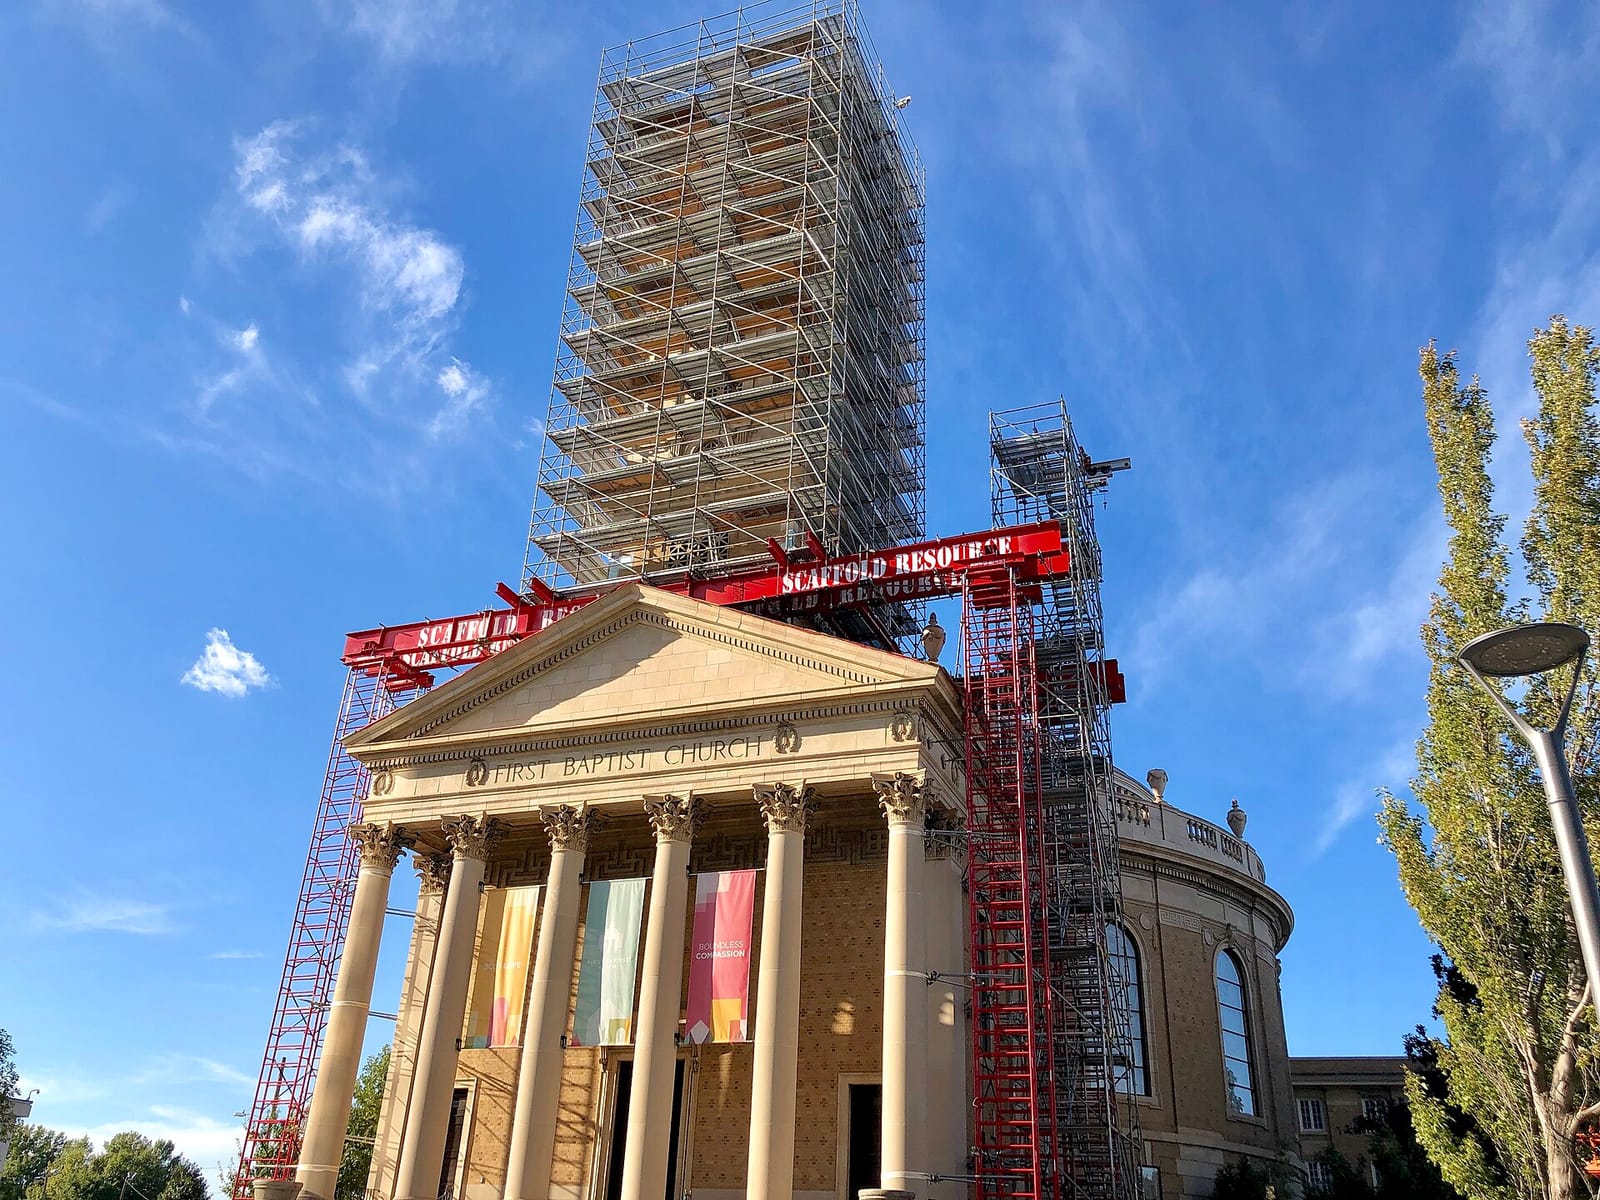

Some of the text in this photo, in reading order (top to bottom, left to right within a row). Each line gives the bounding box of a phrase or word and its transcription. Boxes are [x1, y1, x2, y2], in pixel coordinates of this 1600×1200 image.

[782, 557, 887, 594] SCAFFOLD
[417, 615, 516, 647] SCAFFOLD
[494, 735, 761, 784] FIRST BAPTIST CHURCH
[696, 950, 745, 960] COMPASSION
[698, 940, 745, 951] BOUNDLESS
